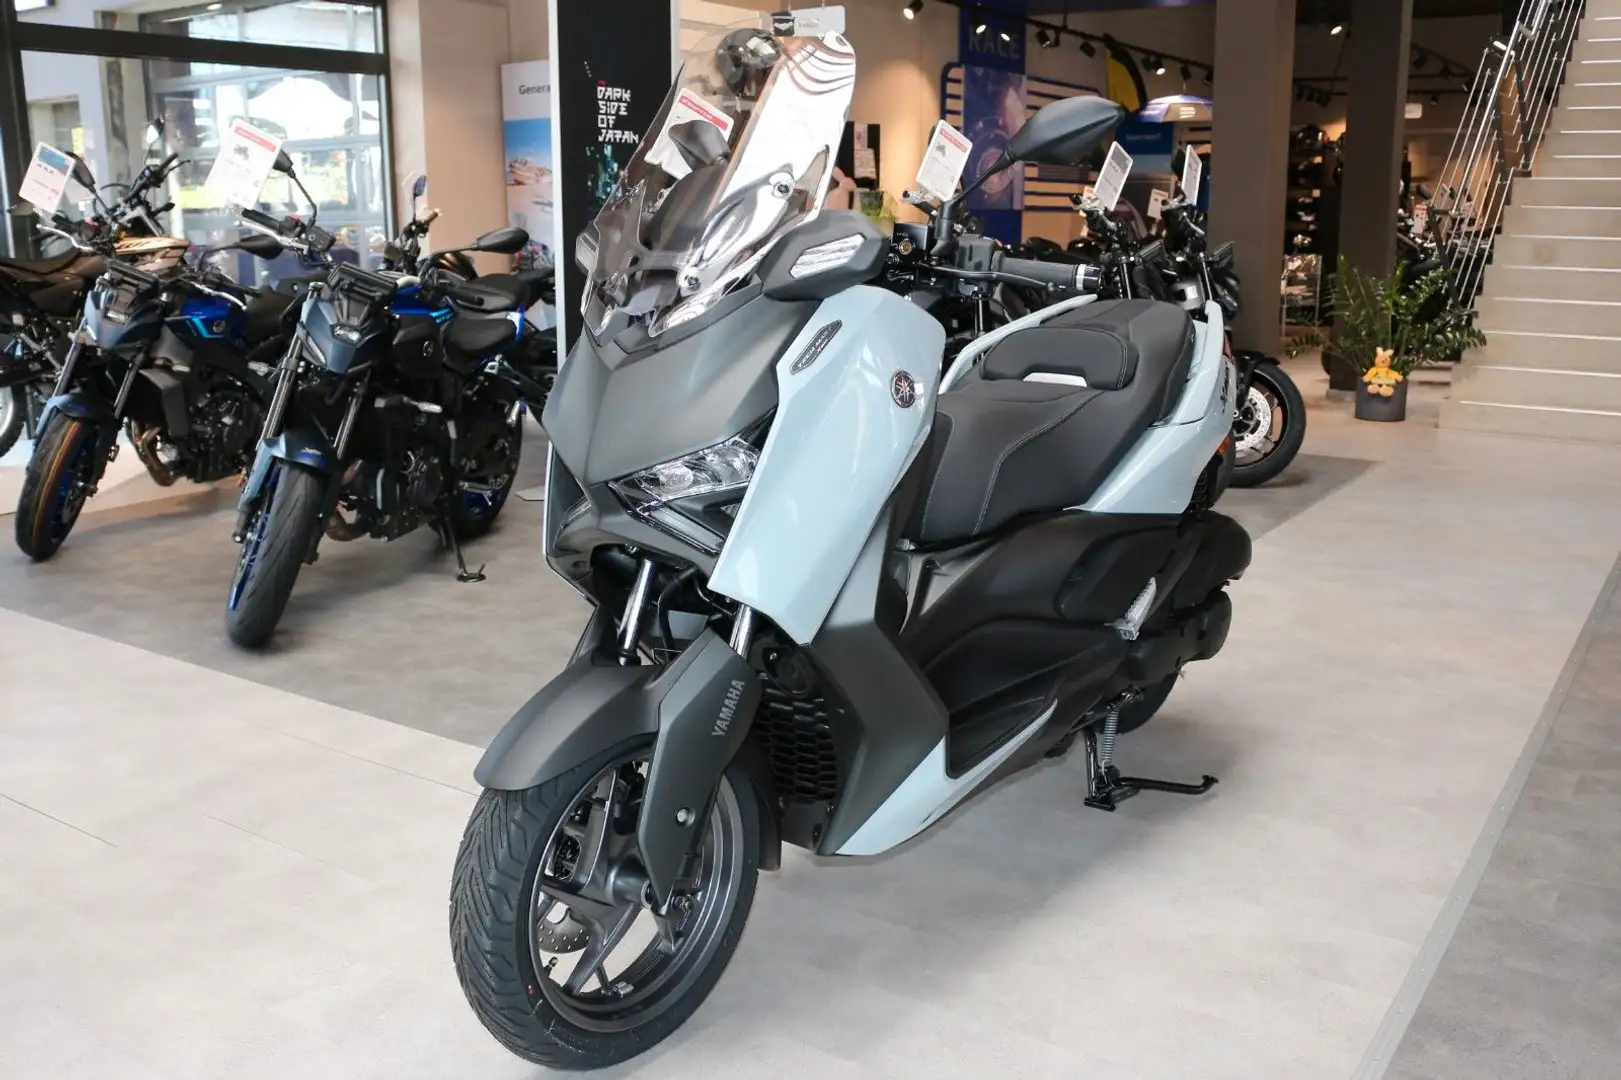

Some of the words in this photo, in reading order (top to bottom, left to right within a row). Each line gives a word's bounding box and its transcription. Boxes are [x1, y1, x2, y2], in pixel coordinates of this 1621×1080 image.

[596, 86, 631, 102] DARK
[597, 114, 616, 128] OF
[598, 129, 639, 144] JAPAN
[711, 679, 745, 737] YAMAHA
